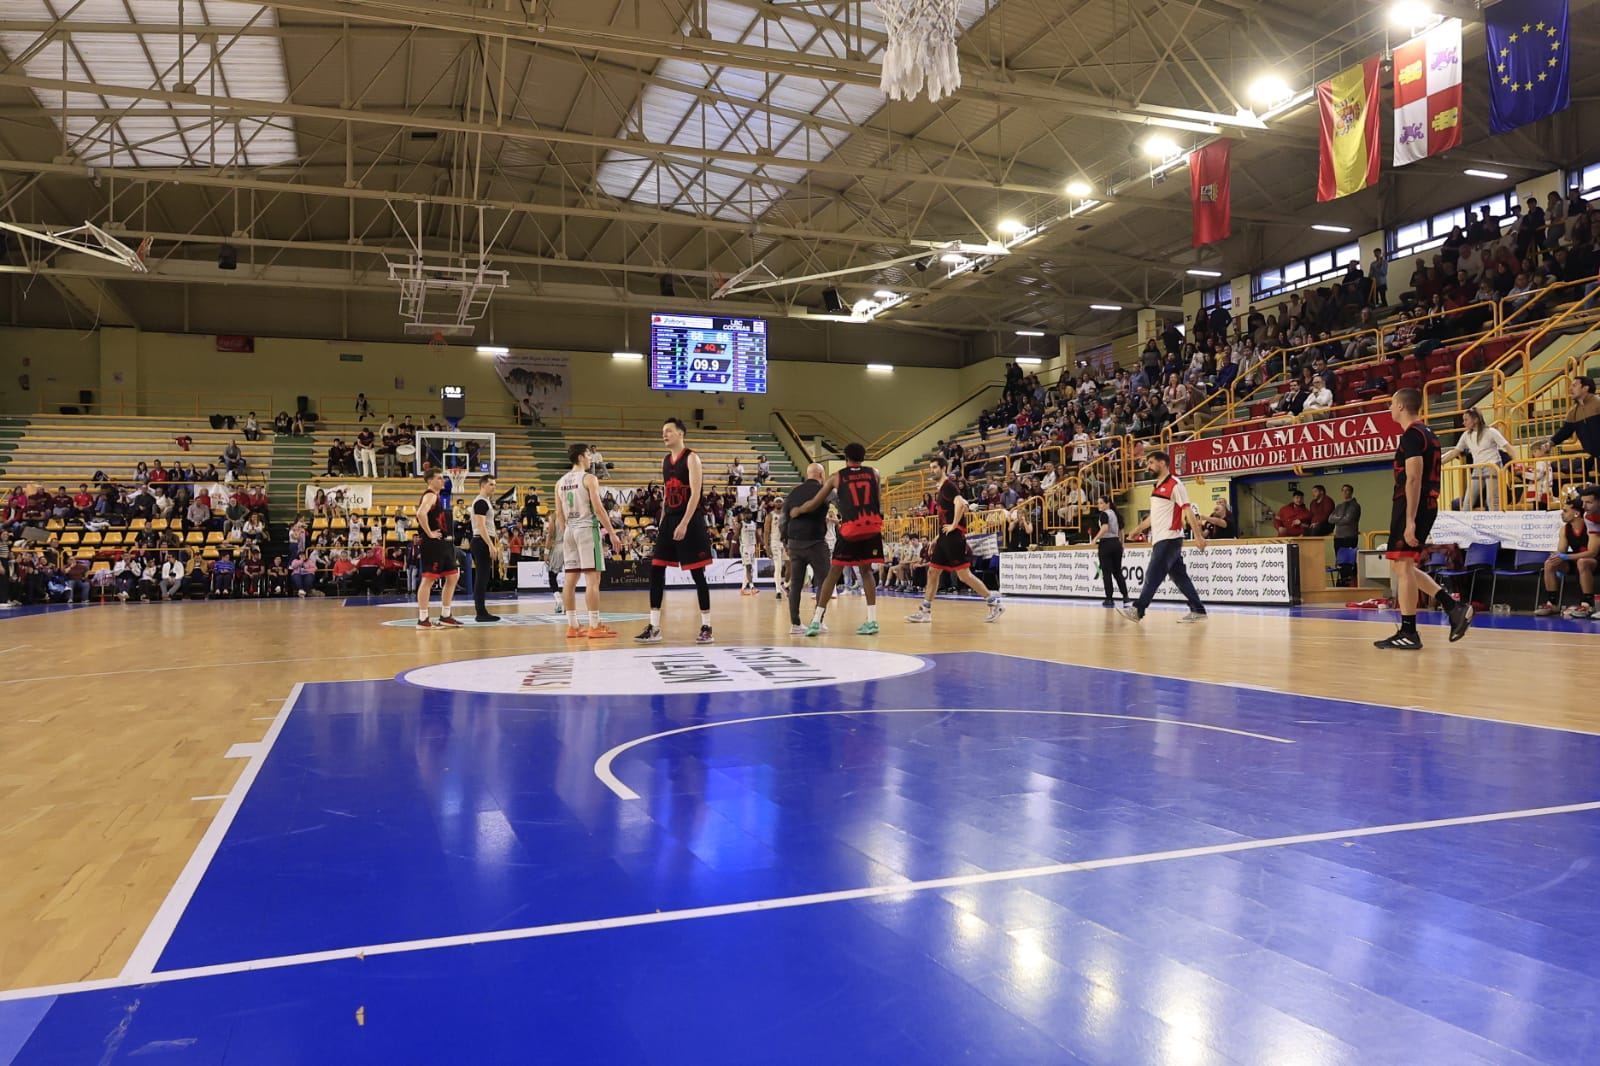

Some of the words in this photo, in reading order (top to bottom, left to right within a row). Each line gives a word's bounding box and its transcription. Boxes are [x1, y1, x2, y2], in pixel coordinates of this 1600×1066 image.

[693, 359, 719, 371] 09.9
[1212, 416, 1379, 455] SALAMANCA
[1191, 452, 1265, 474] PATRIMONIO
[1268, 449, 1287, 465] DE
[1291, 445, 1309, 462] LA
[567, 491, 574, 509] 9
[848, 481, 870, 507] 17
[723, 647, 836, 684] CASTILLA
